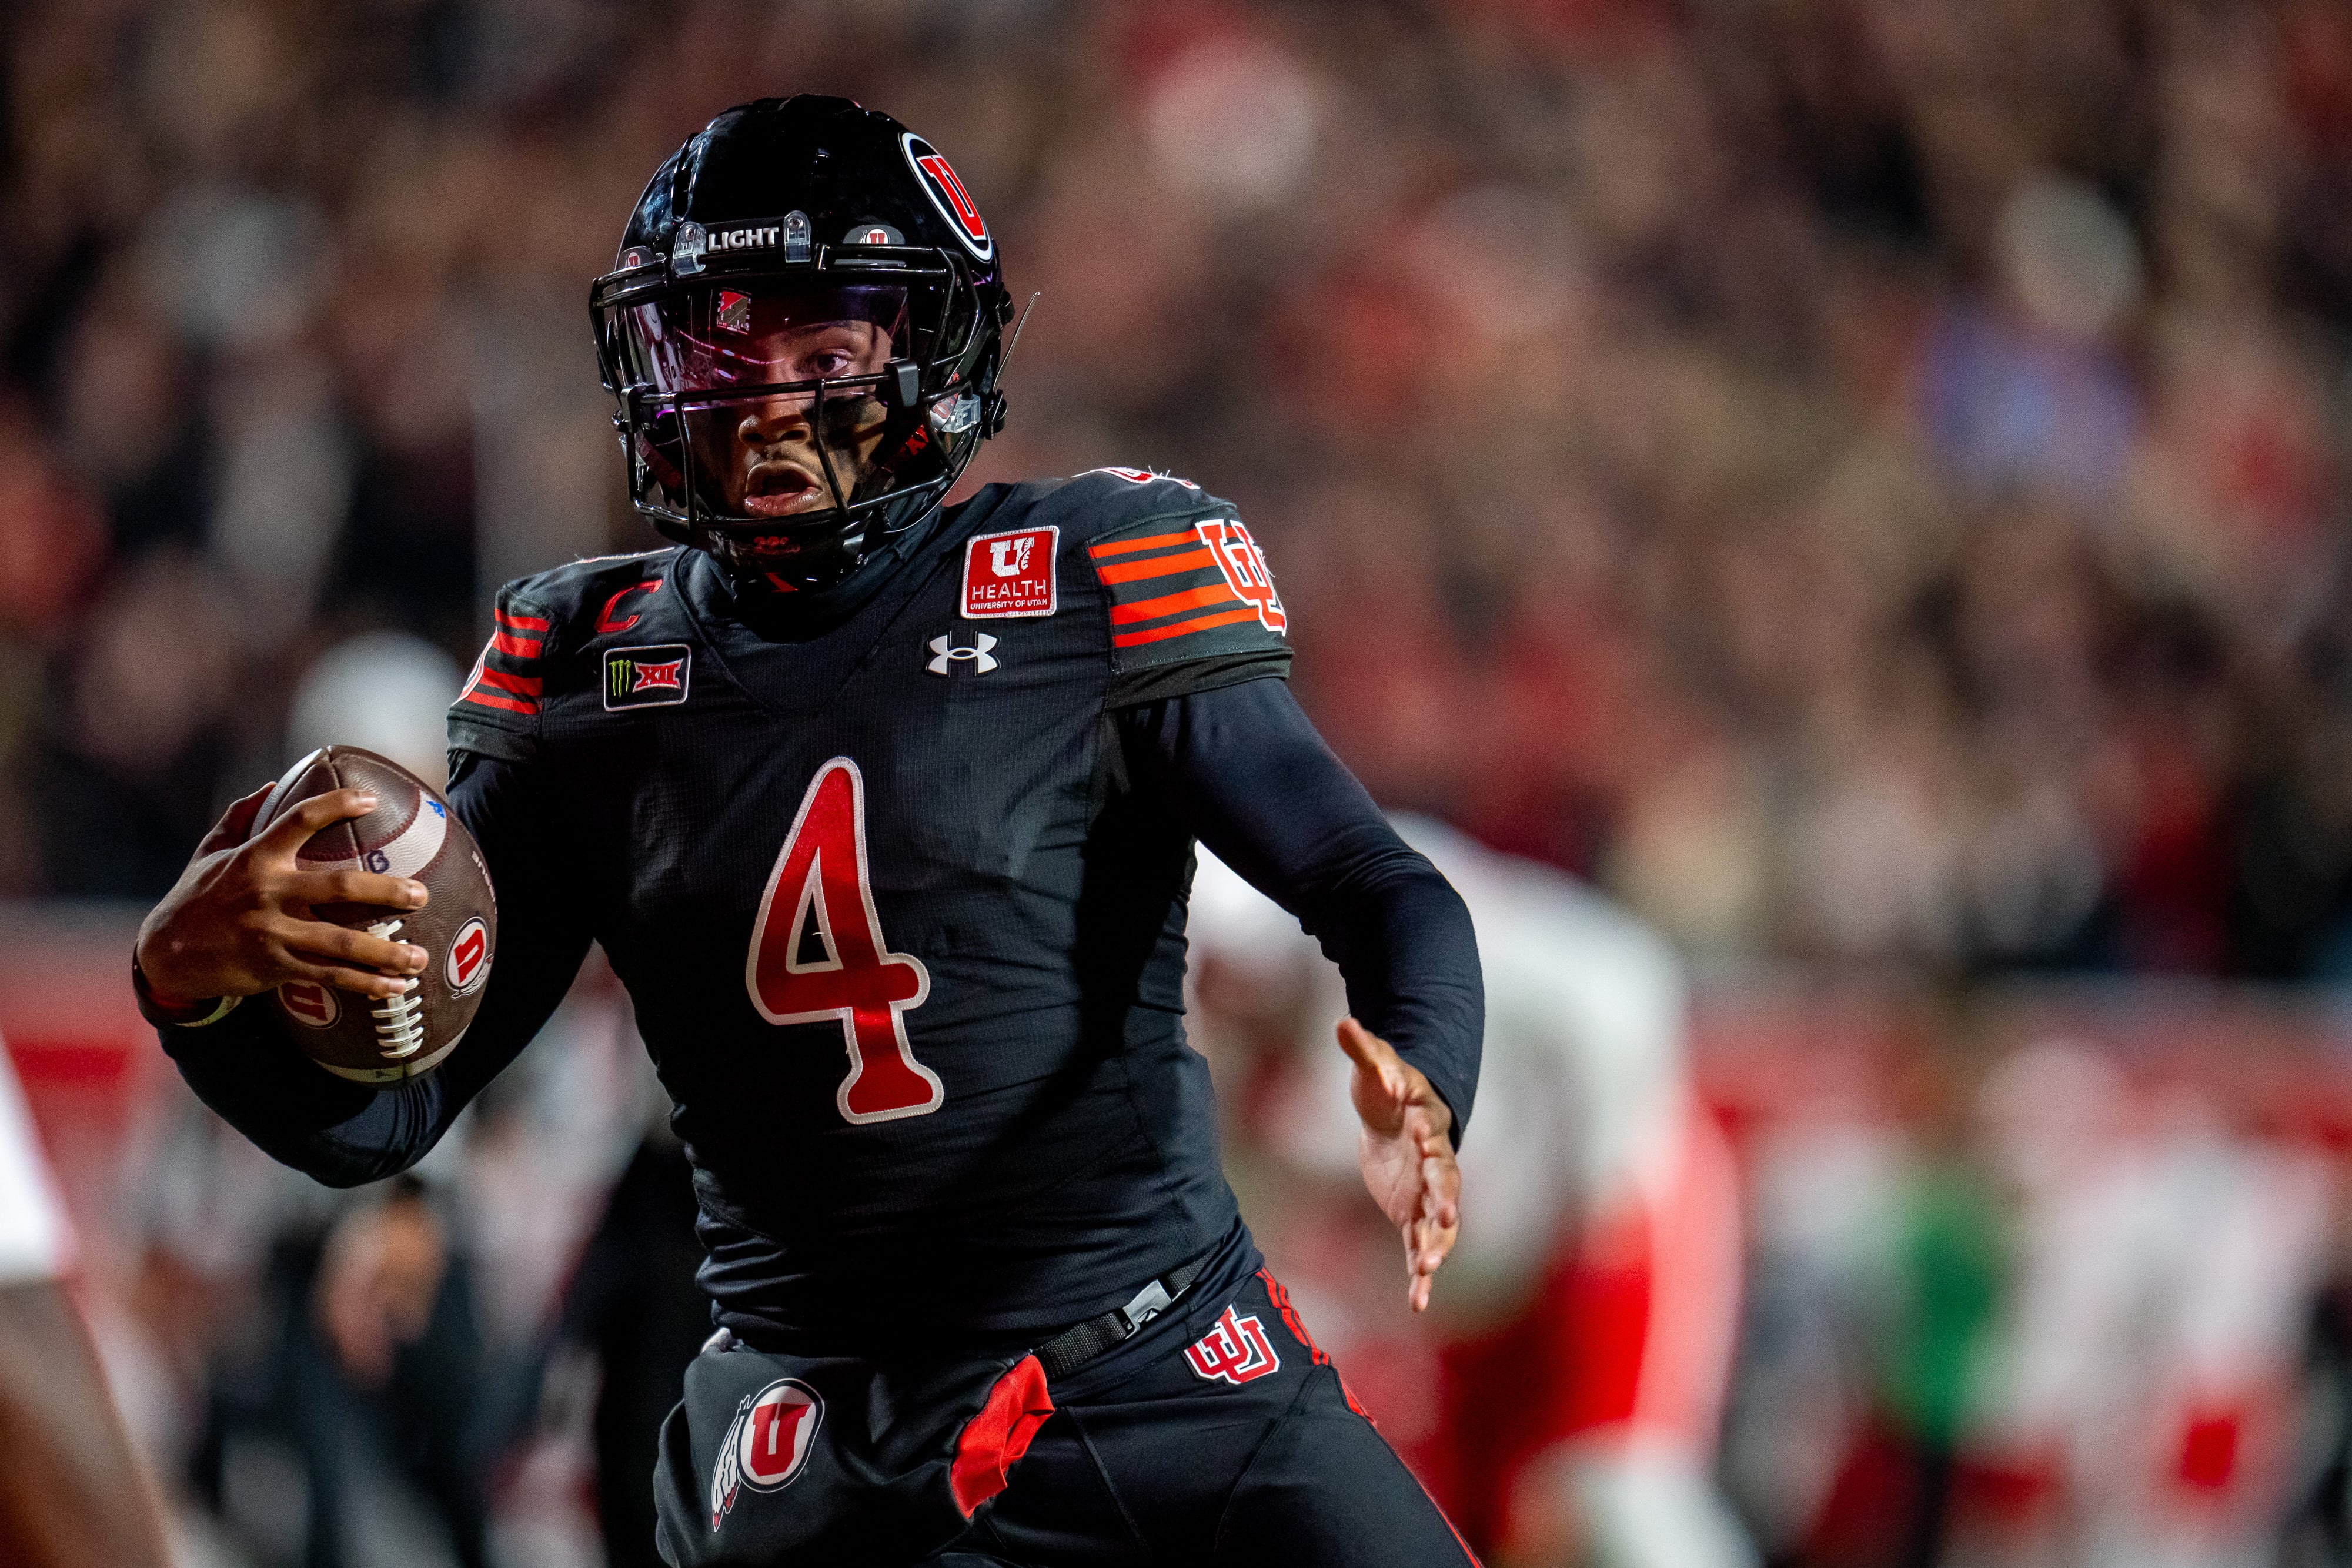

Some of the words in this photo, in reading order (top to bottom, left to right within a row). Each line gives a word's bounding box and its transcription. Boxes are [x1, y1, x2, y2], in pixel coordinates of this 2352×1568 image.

[916, 155, 987, 241] U
[708, 226, 779, 252] LIGHT
[990, 536, 1035, 577] U
[594, 579, 664, 633] C
[970, 600, 1014, 610] UNIVERSITY
[1015, 599, 1026, 607] OF
[1027, 598, 1048, 606] UTAH
[971, 579, 1047, 600] HEALTH
[453, 928, 485, 984] U
[745, 755, 944, 1125] 4
[750, 1403, 811, 1477] U
